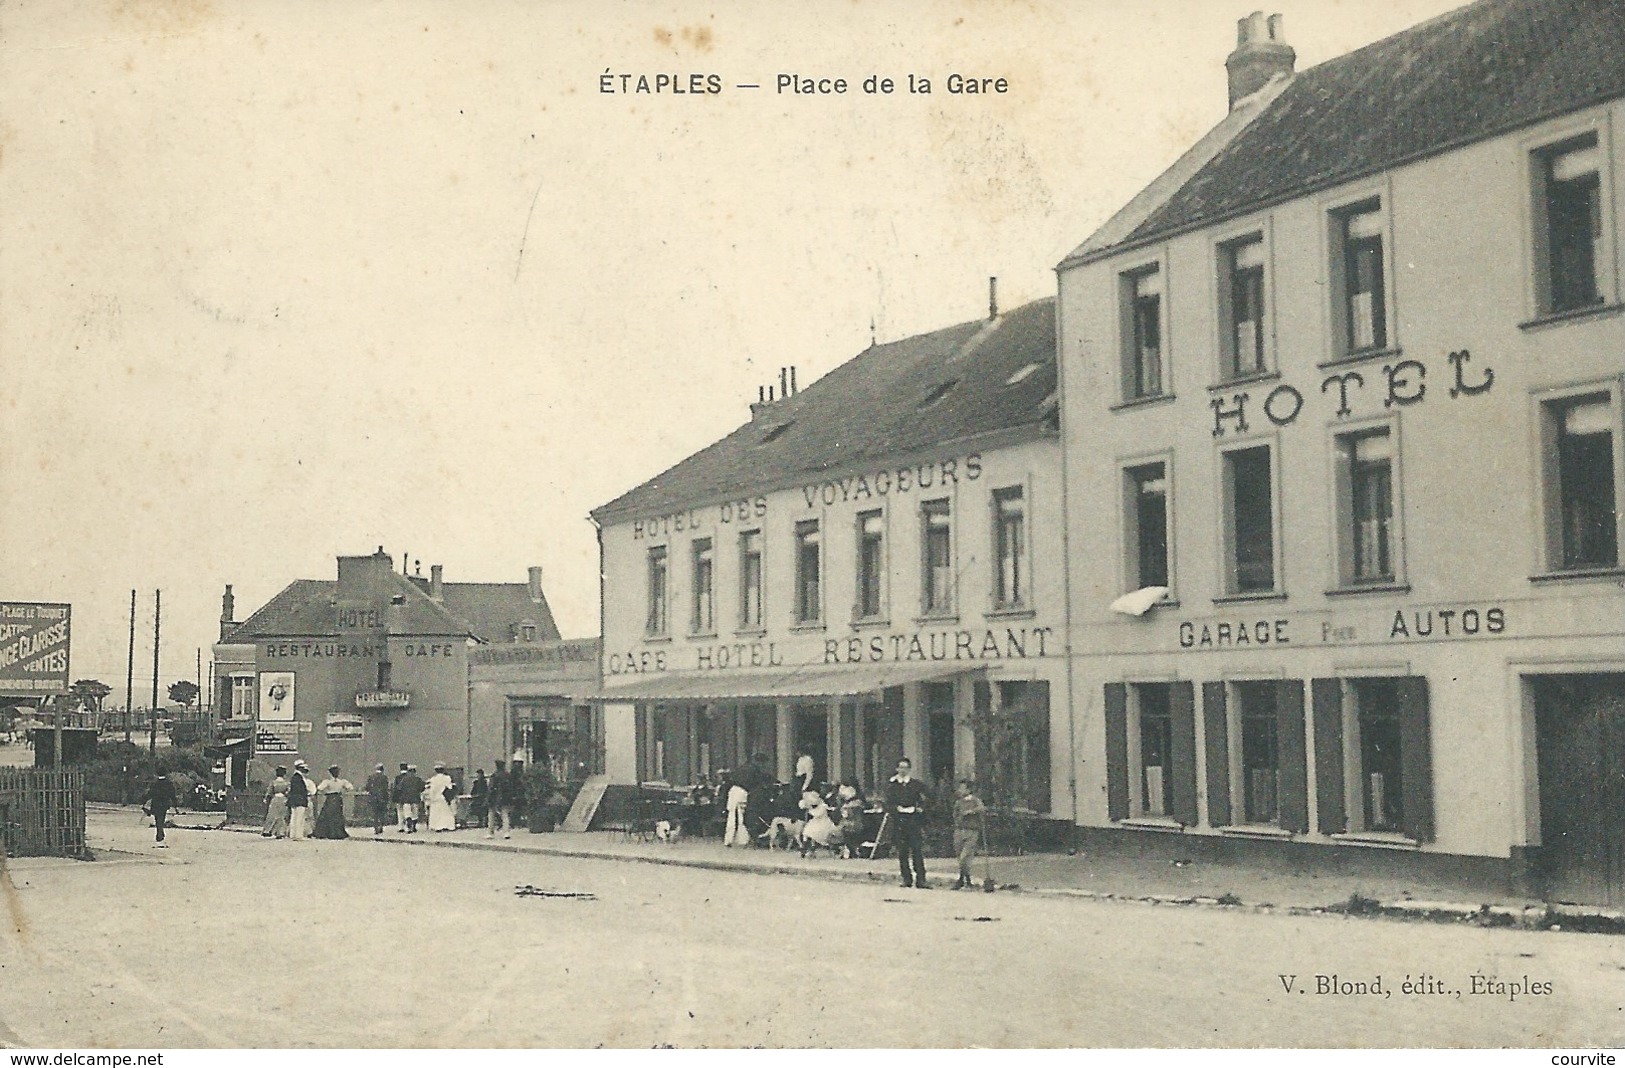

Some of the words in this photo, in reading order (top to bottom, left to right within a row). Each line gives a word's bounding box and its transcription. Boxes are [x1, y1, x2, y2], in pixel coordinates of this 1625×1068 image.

[1210, 350, 1494, 437] HOTEL
[633, 508, 700, 540] HOTEL
[720, 496, 767, 524] DES
[802, 453, 982, 508] VOYAGEURS
[338, 609, 385, 628] HOTEL
[1179, 619, 1290, 647] GARAGE
[1391, 608, 1505, 638] AUTOS
[19, 620, 67, 659] CLARISSE
[267, 644, 385, 657] RESTAURANT
[405, 645, 453, 657] CAFE
[608, 650, 668, 675] CAFE
[697, 643, 783, 670] HOTEL
[824, 627, 1053, 663] RESTAURANT
[23, 649, 67, 671] VENTES
